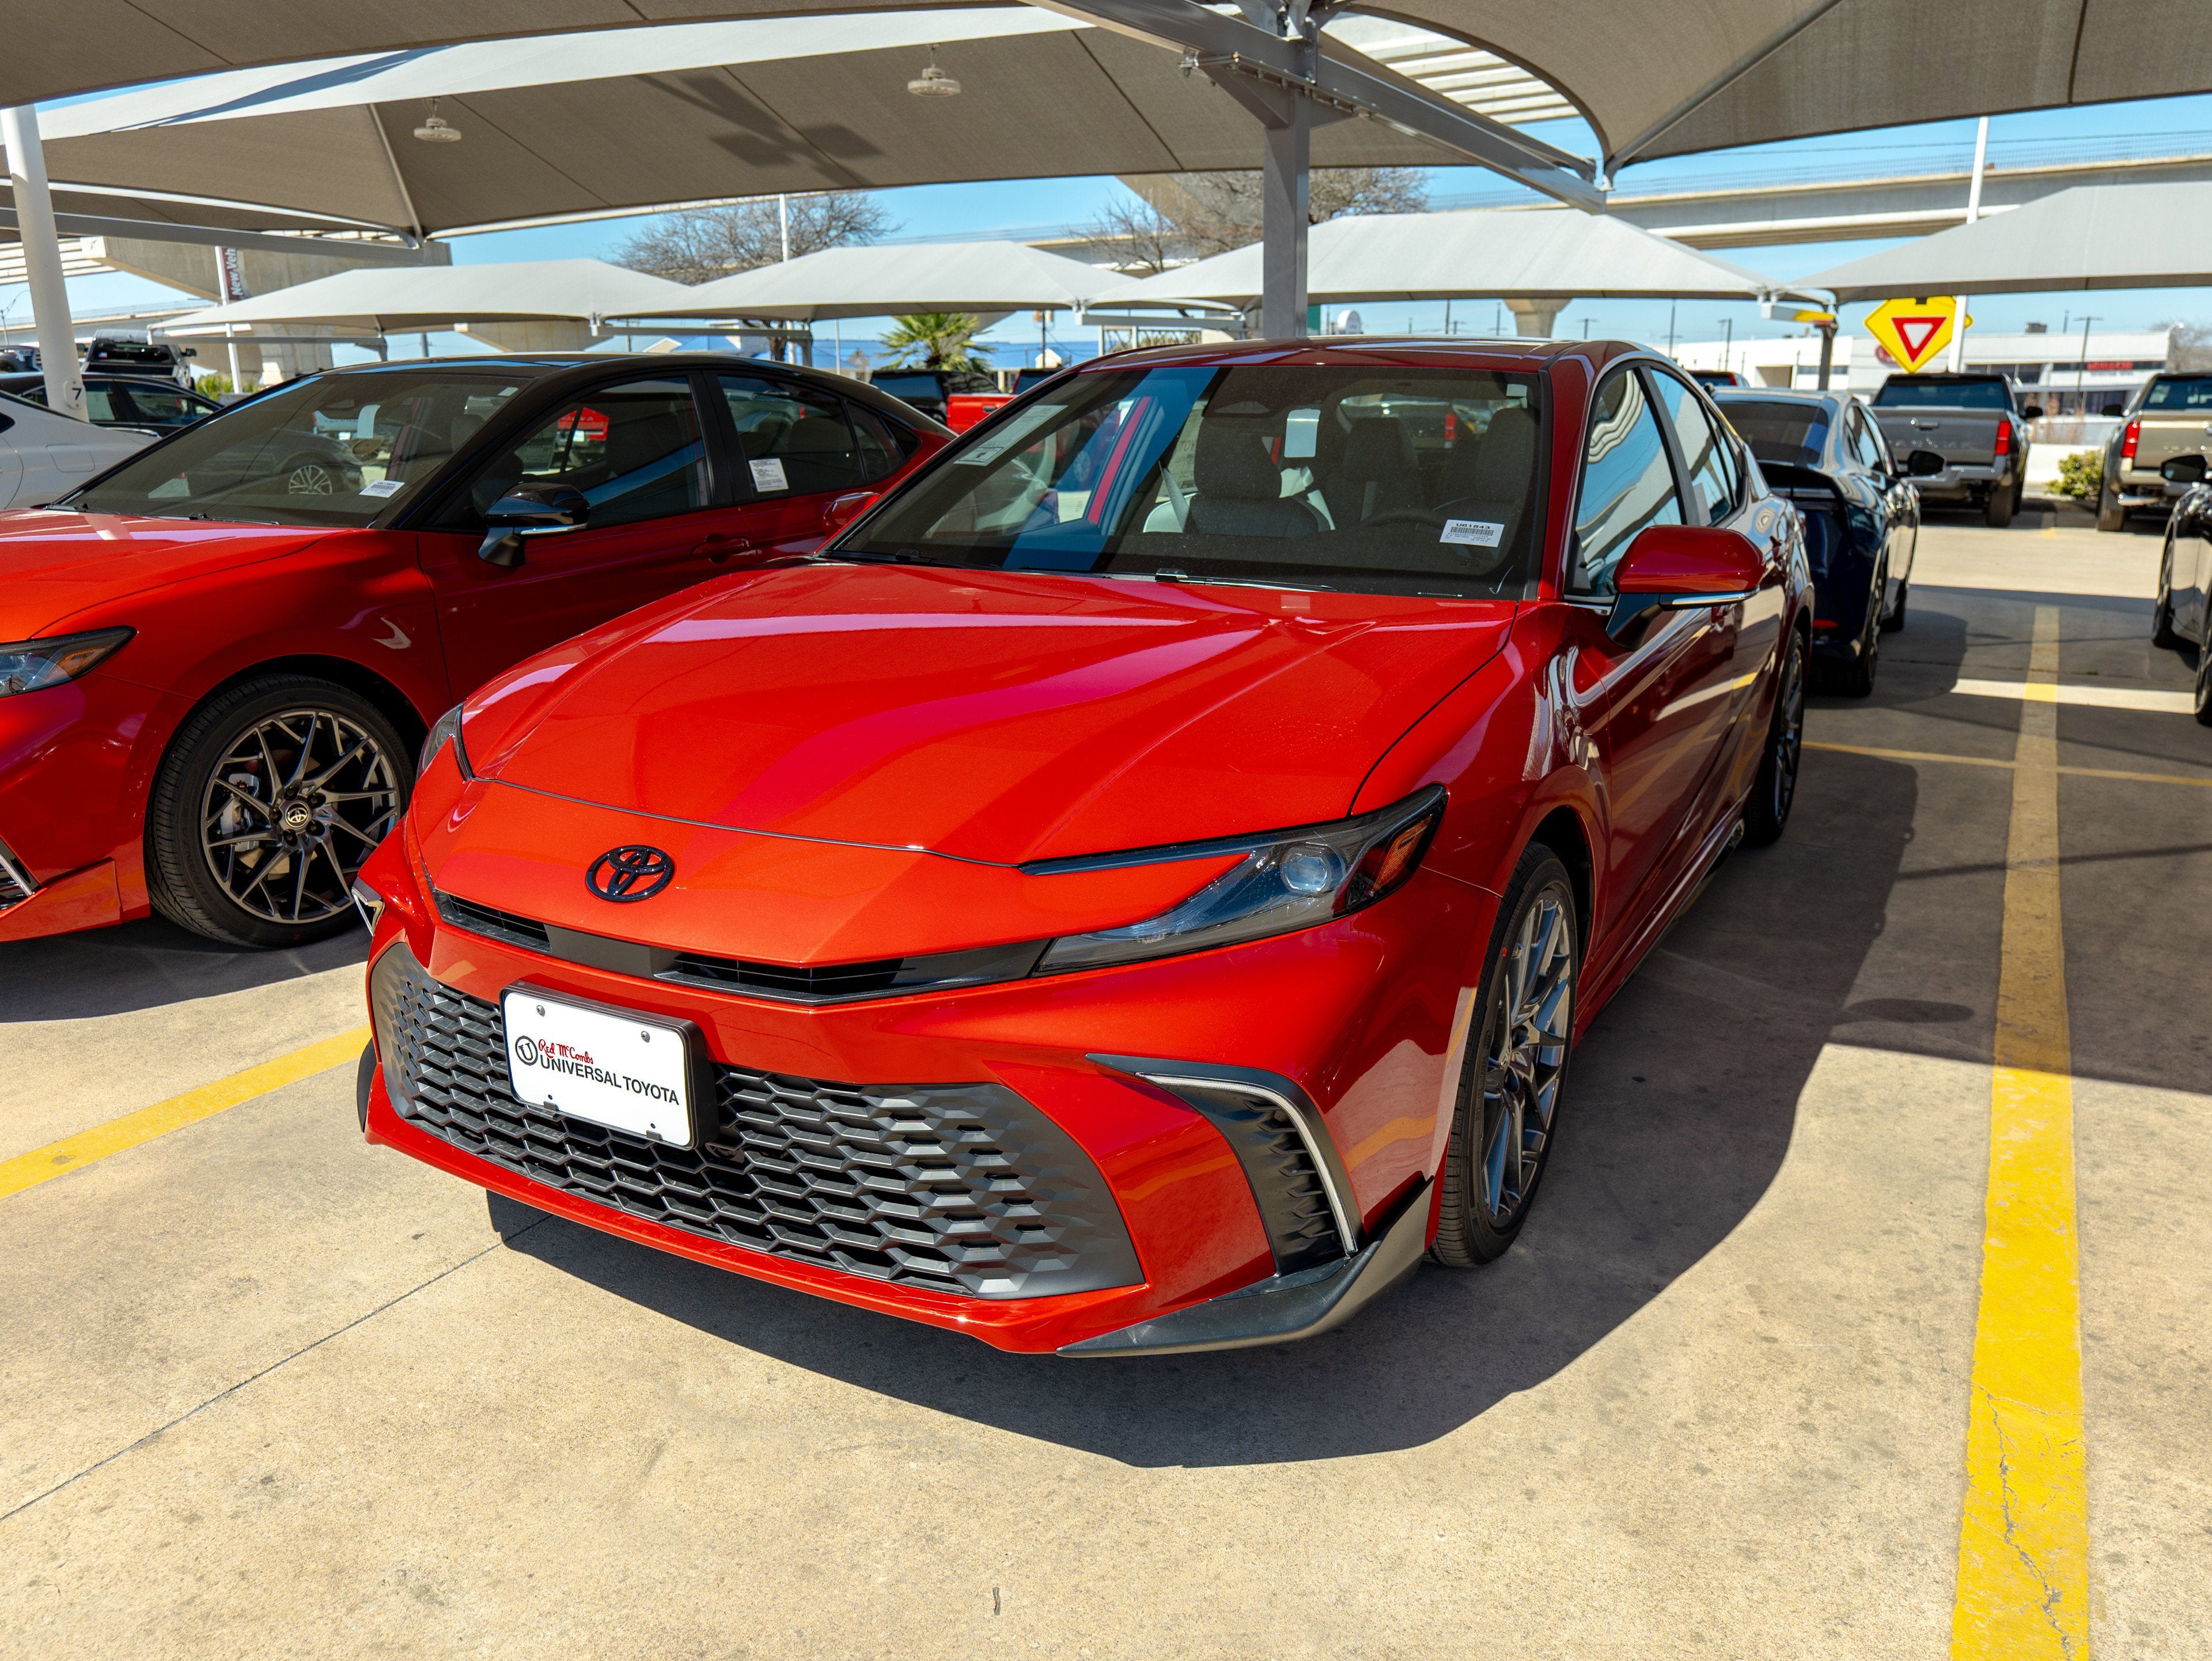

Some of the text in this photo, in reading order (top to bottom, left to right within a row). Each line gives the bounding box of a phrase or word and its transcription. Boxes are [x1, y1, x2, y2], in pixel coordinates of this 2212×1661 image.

[225, 248, 244, 296] New Veh
[72, 388, 82, 400] 7
[539, 1039, 594, 1064] Red McCombs
[540, 1054, 679, 1106] UNIVERSAL TOYOTA
